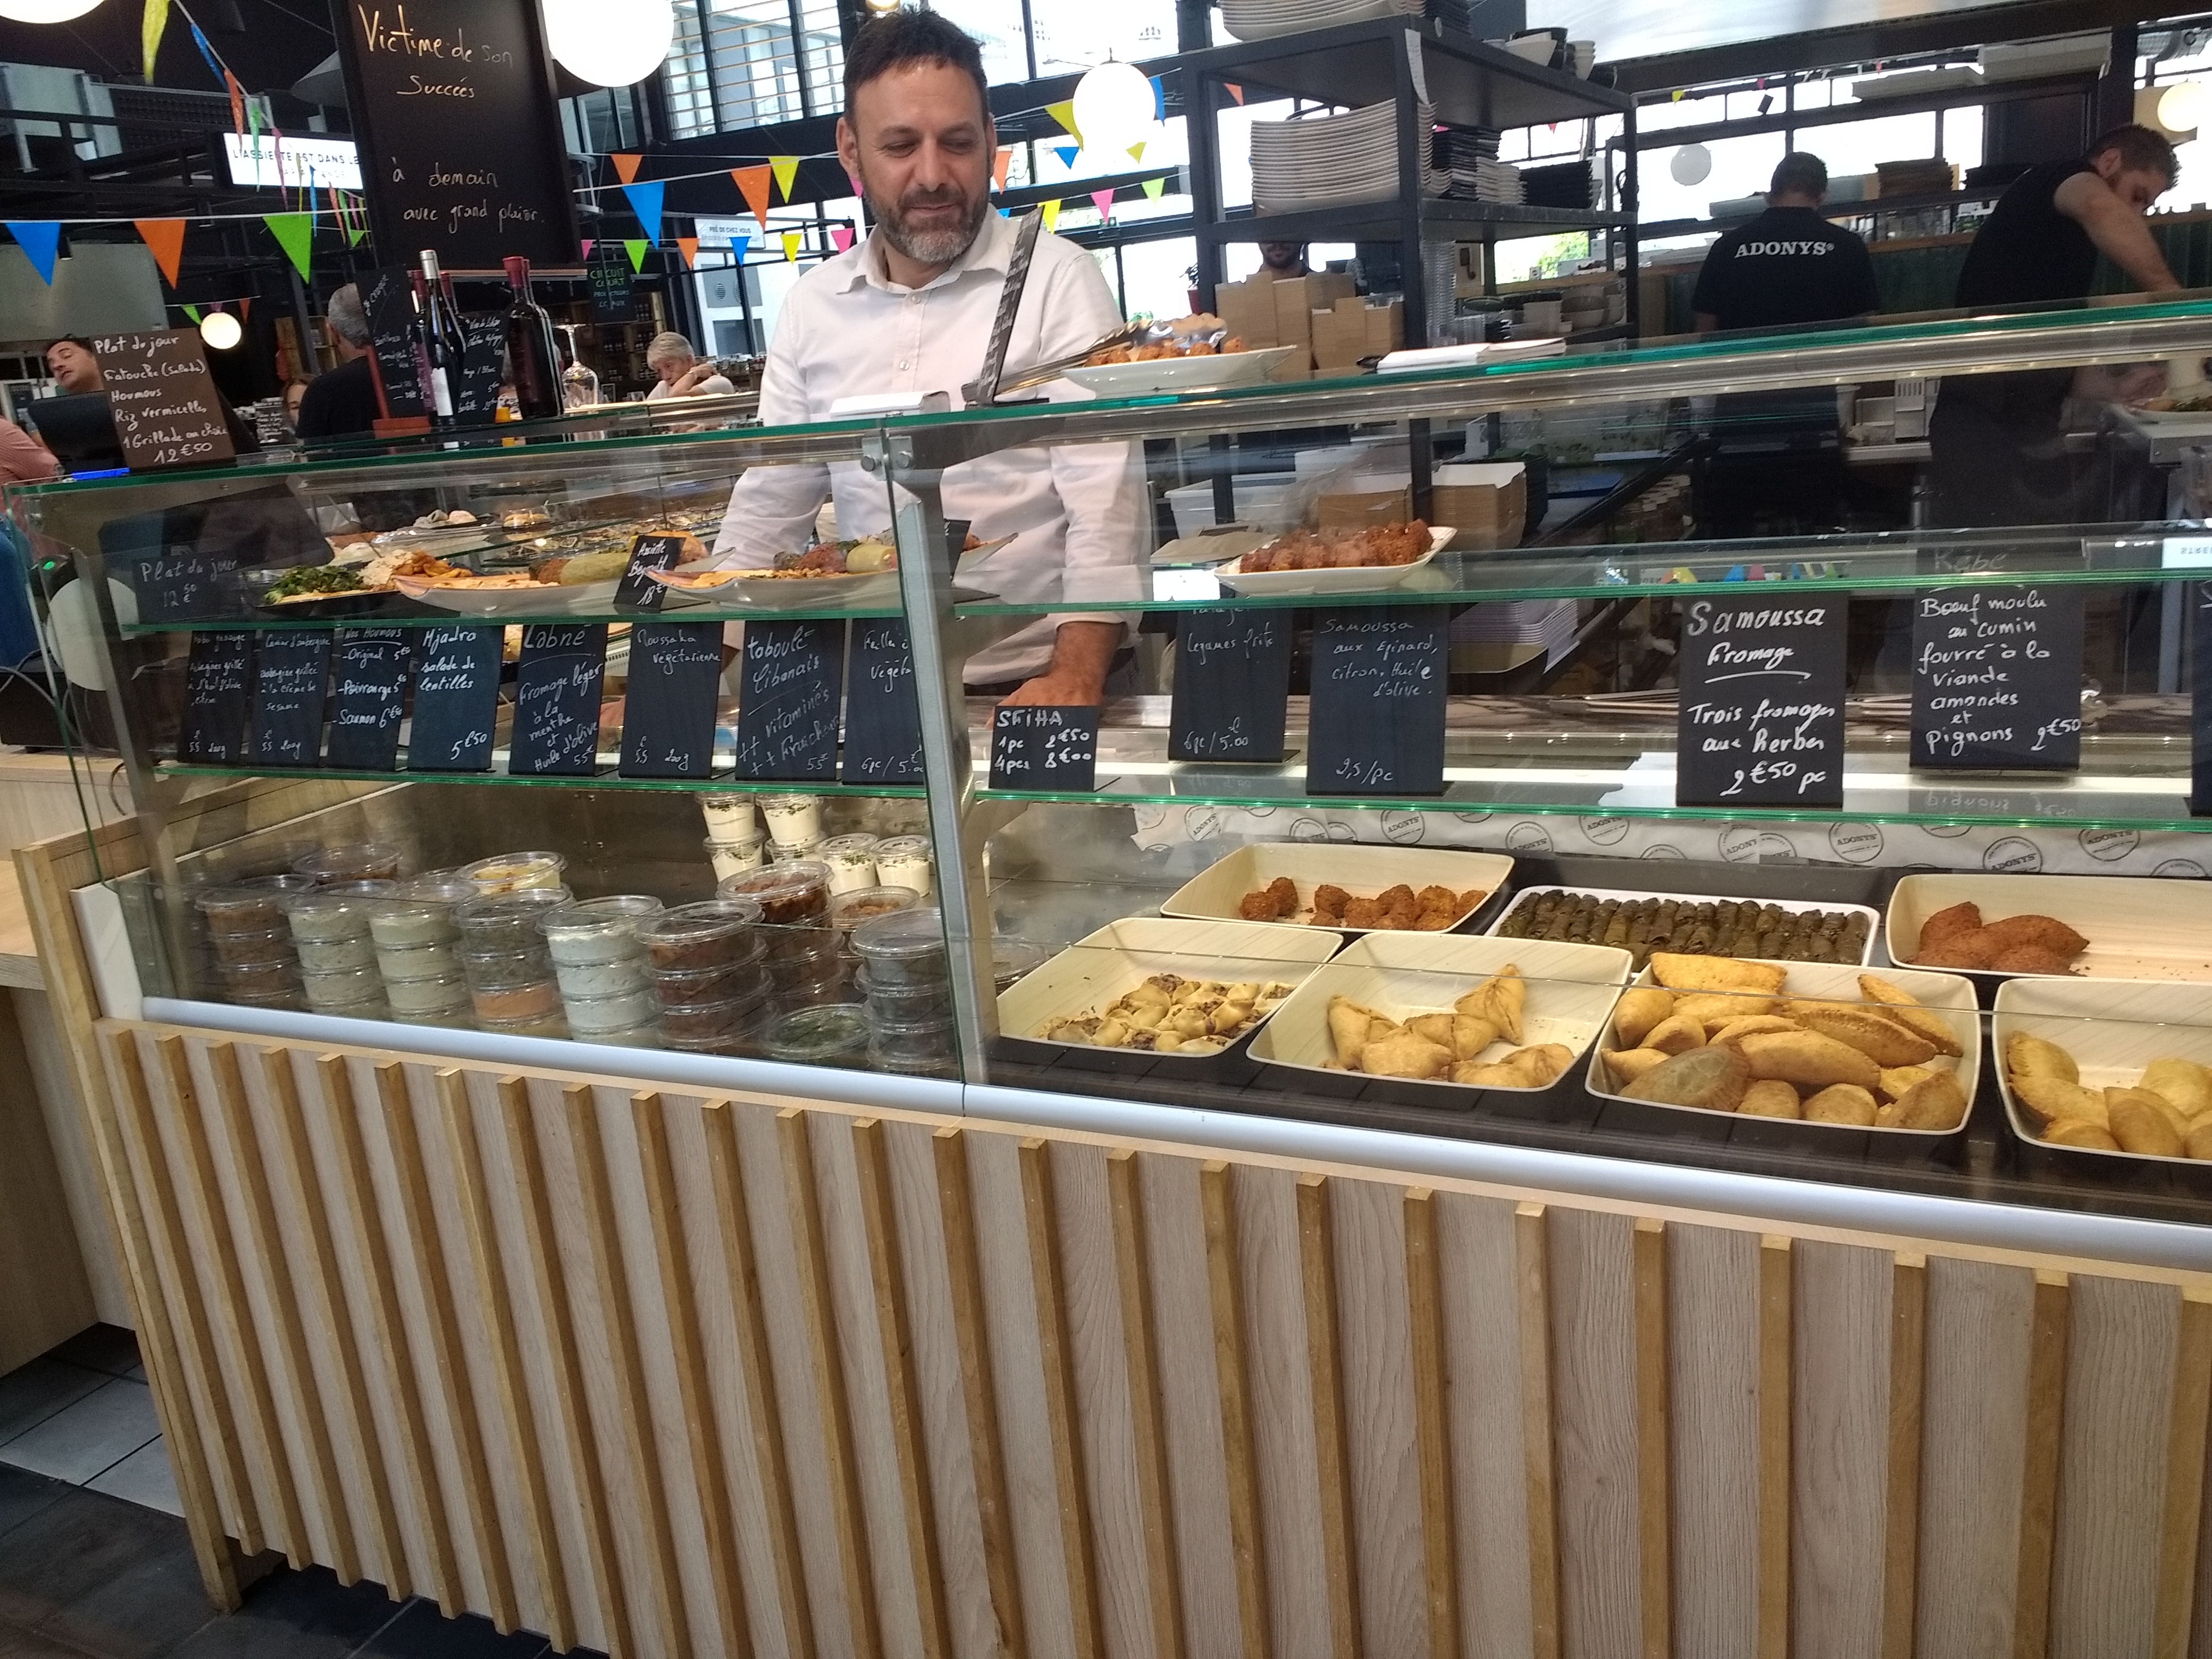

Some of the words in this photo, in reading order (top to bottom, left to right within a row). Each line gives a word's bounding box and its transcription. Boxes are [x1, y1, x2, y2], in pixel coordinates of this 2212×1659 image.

[358, 4, 444, 58] Victime
[451, 28, 473, 63] de
[296, 153, 314, 162] ST
[318, 154, 345, 164] DANS
[429, 162, 498, 187] demain
[403, 208, 438, 221] avec
[448, 199, 488, 234] grand
[94, 335, 127, 354] Plat
[147, 337, 179, 357] jour
[115, 408, 138, 431] Riz
[140, 561, 183, 583] Plat
[1686, 600, 1826, 636] Samoussa
[421, 655, 458, 673] salade
[419, 673, 474, 692] lentilles
[1686, 702, 1743, 725] Trois
[1950, 710, 1973, 725] et
[1797, 770, 1827, 795] pc
[1387, 816, 1420, 833] ADONYS
[1837, 834, 1878, 846] ADONYS
